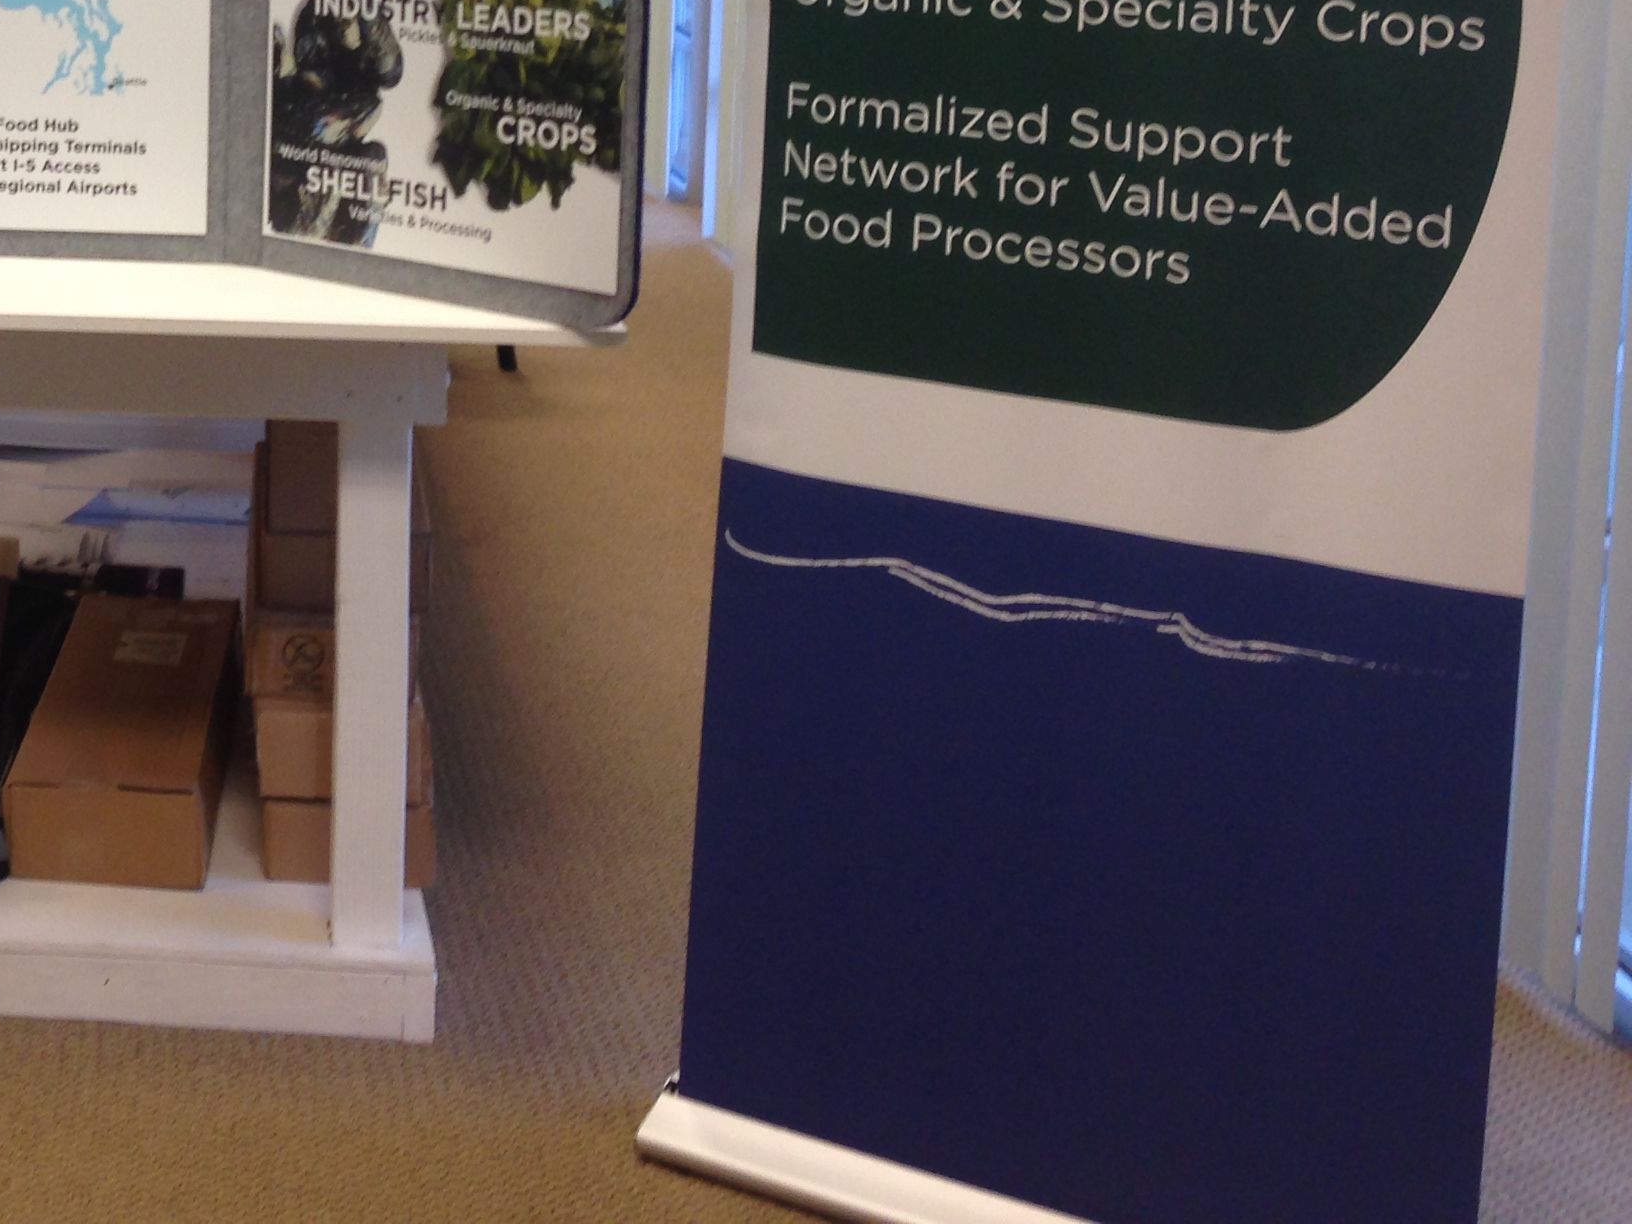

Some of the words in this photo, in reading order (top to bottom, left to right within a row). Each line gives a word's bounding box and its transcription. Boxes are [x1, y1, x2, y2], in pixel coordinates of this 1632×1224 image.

[456, 1, 592, 41] LEADERS
[445, 88, 500, 111] Organic
[45, 119, 79, 133] Hub
[495, 116, 598, 156] CROPS
[787, 81, 1049, 146] Formalized
[1070, 106, 1292, 168] Support
[42, 160, 100, 174] Access
[65, 140, 147, 155] Terminals
[67, 180, 138, 196] Airports
[306, 165, 448, 211] SHELLFISH
[784, 140, 978, 199] Network
[997, 161, 1068, 207] for
[1089, 171, 1453, 249] Value-Added
[780, 198, 892, 249] Food
[912, 213, 1191, 286] Processors
